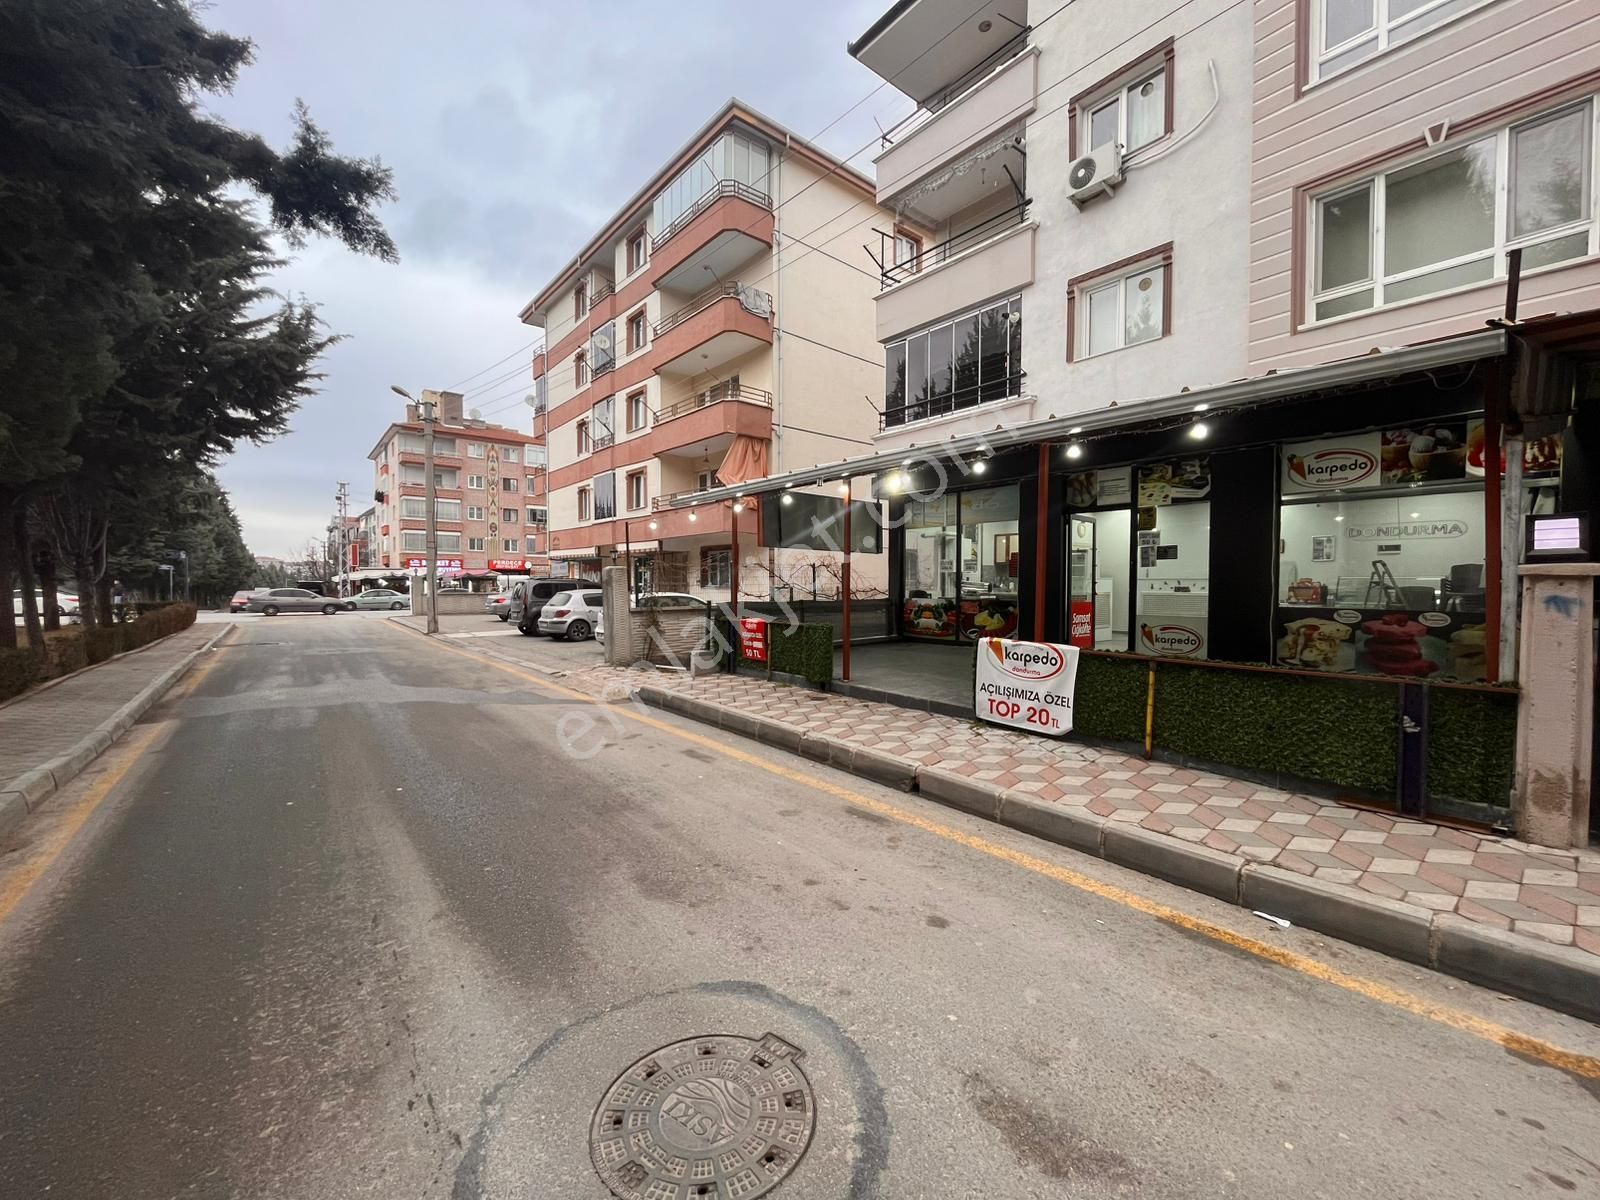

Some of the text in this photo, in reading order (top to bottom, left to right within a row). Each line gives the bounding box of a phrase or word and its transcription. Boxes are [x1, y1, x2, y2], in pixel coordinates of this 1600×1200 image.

[1307, 459, 1368, 477] karpedo
[1349, 523, 1463, 538] DONDURMA
[1155, 633, 1198, 649] karpedo
[1004, 646, 1058, 667] karpedo
[1012, 666, 1041, 676] dondurma
[979, 682, 1071, 709] AÇILIŞIMIZA ÖZEL
[988, 698, 1020, 719] TOP
